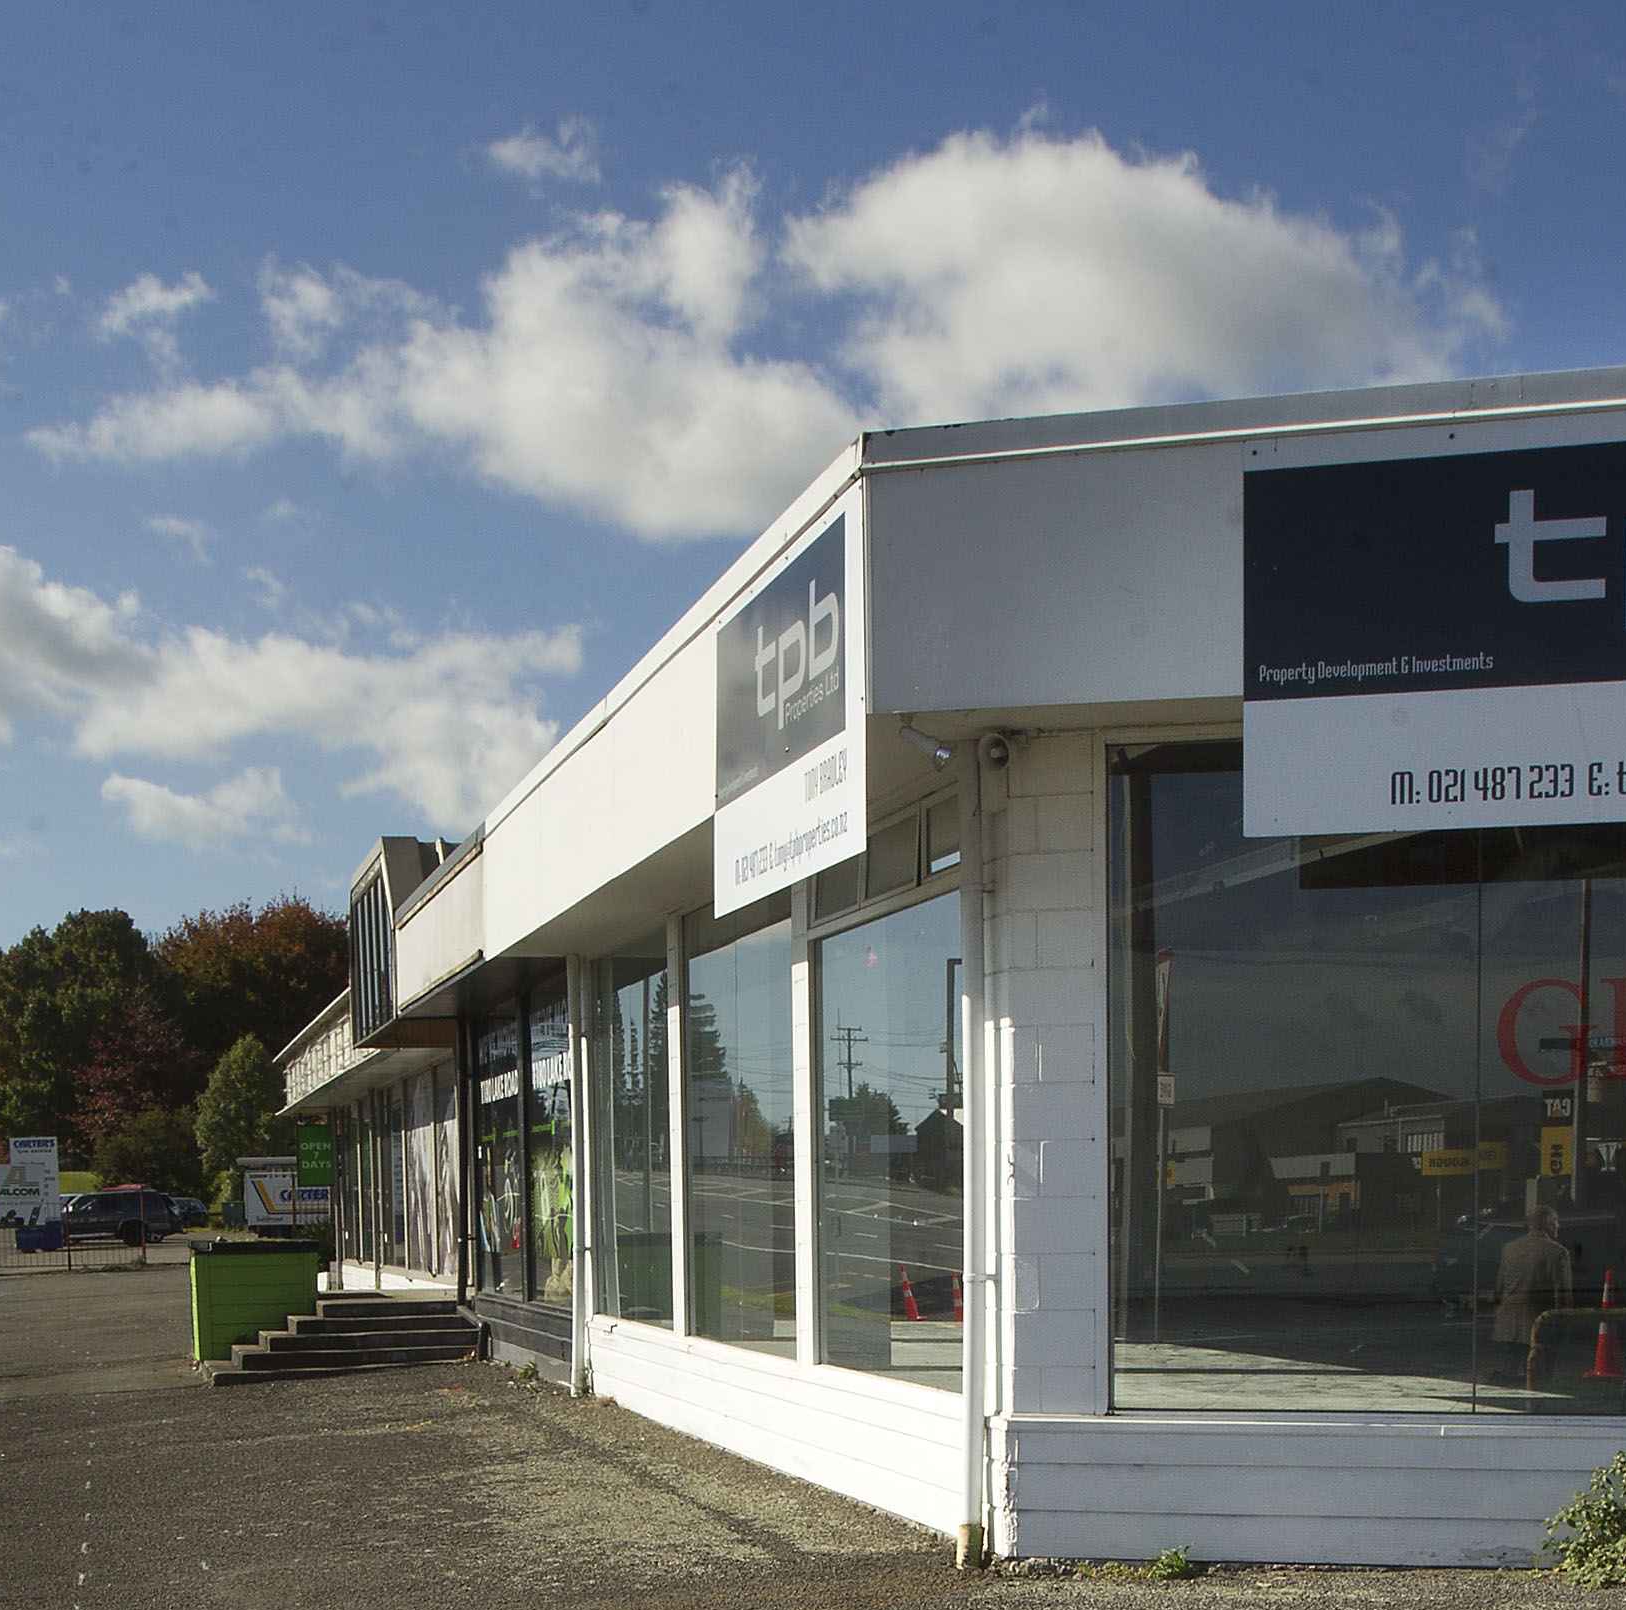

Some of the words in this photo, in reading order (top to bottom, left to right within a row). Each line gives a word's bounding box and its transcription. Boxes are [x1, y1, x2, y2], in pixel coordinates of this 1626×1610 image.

[755, 579, 839, 730] tpb
[1259, 662, 1316, 686] Property
[1317, 658, 1399, 682] Development
[1412, 652, 1494, 673] Investments
[785, 681, 824, 725] Properties
[825, 665, 840, 695] Ltd
[1391, 772, 1422, 805] M:
[1427, 768, 1467, 804] 021
[1474, 766, 1522, 802] 487
[1528, 763, 1576, 799] 233
[1587, 762, 1611, 797] E:
[13, 1139, 55, 1149] CARTERS
[300, 1142, 332, 1151] OPEN
[313, 1151, 319, 1159] 7
[301, 1160, 332, 1169] DAYS
